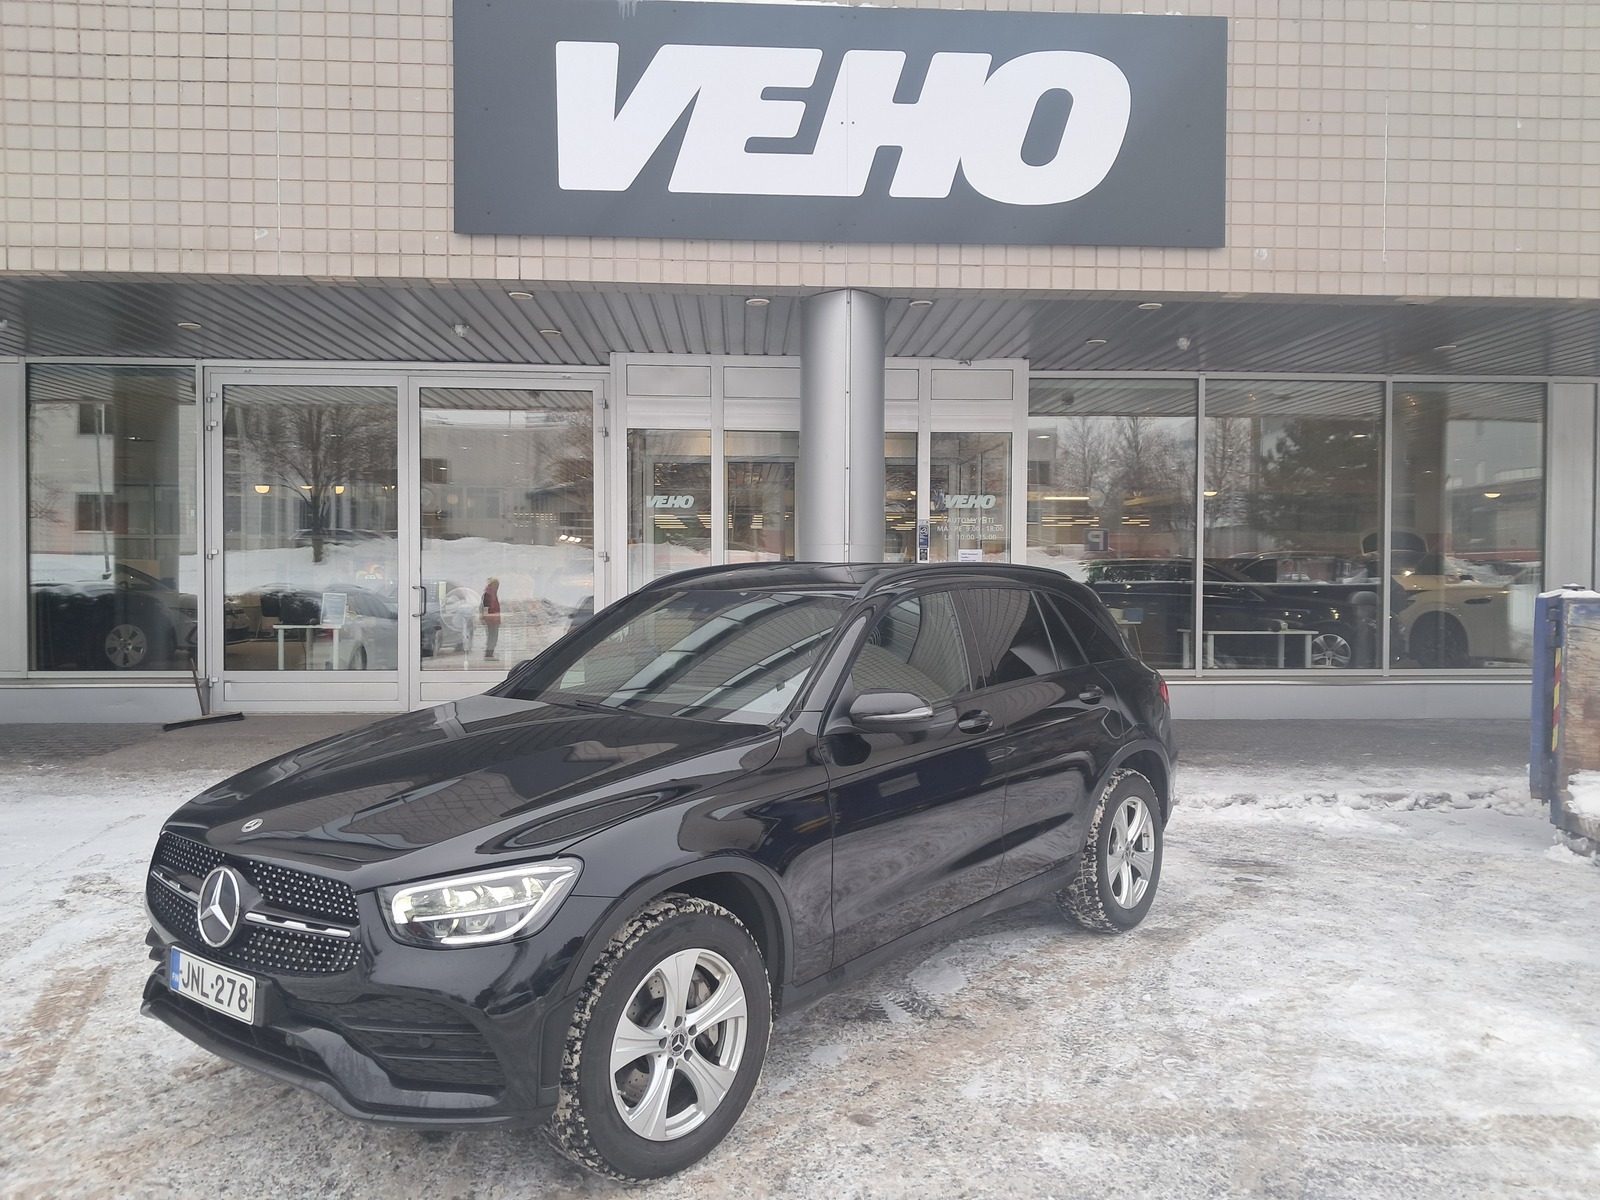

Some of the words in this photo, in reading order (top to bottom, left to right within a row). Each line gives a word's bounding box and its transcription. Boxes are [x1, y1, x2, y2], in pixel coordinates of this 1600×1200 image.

[555, 41, 1132, 206] VEHO
[646, 495, 694, 509] VEHO
[945, 495, 996, 509] VEHO
[181, 961, 248, 1013] JNL-278
